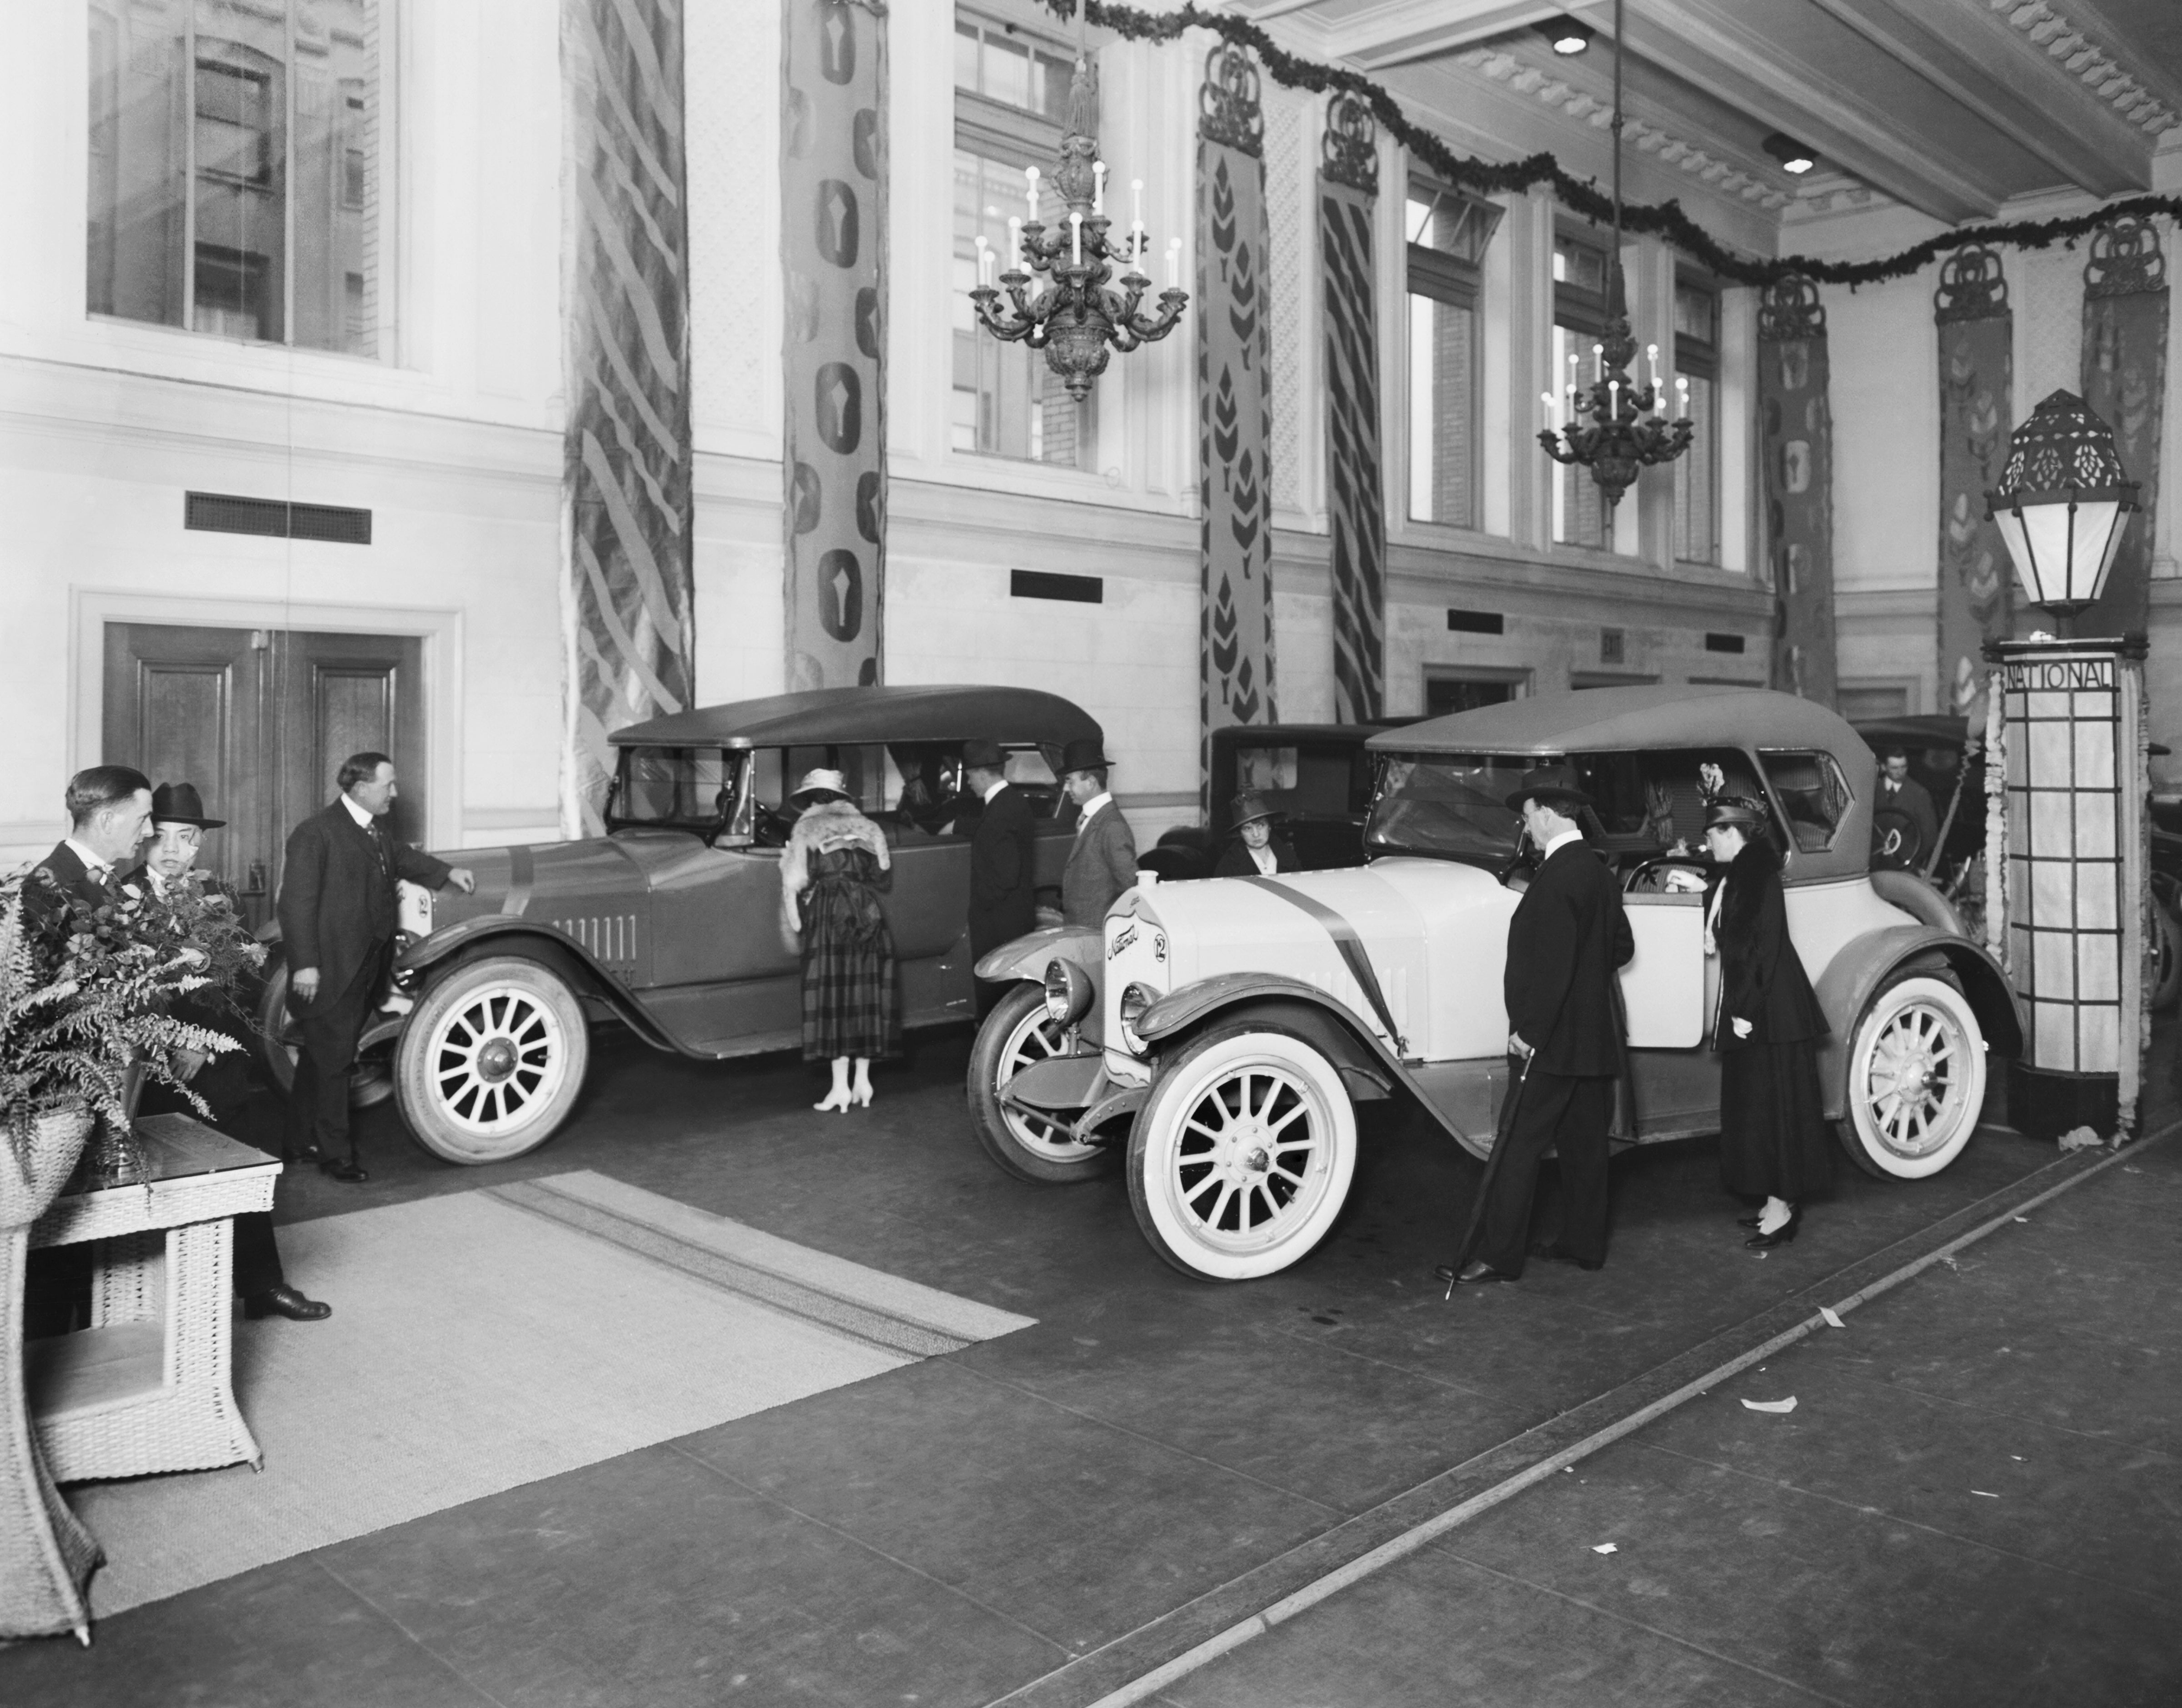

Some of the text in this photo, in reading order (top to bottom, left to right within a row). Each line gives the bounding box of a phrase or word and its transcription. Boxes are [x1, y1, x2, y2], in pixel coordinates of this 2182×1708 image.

[2007, 662, 2110, 688] NATIONAL
[1107, 924, 1138, 960] National
[1155, 938, 1166, 959] 12
